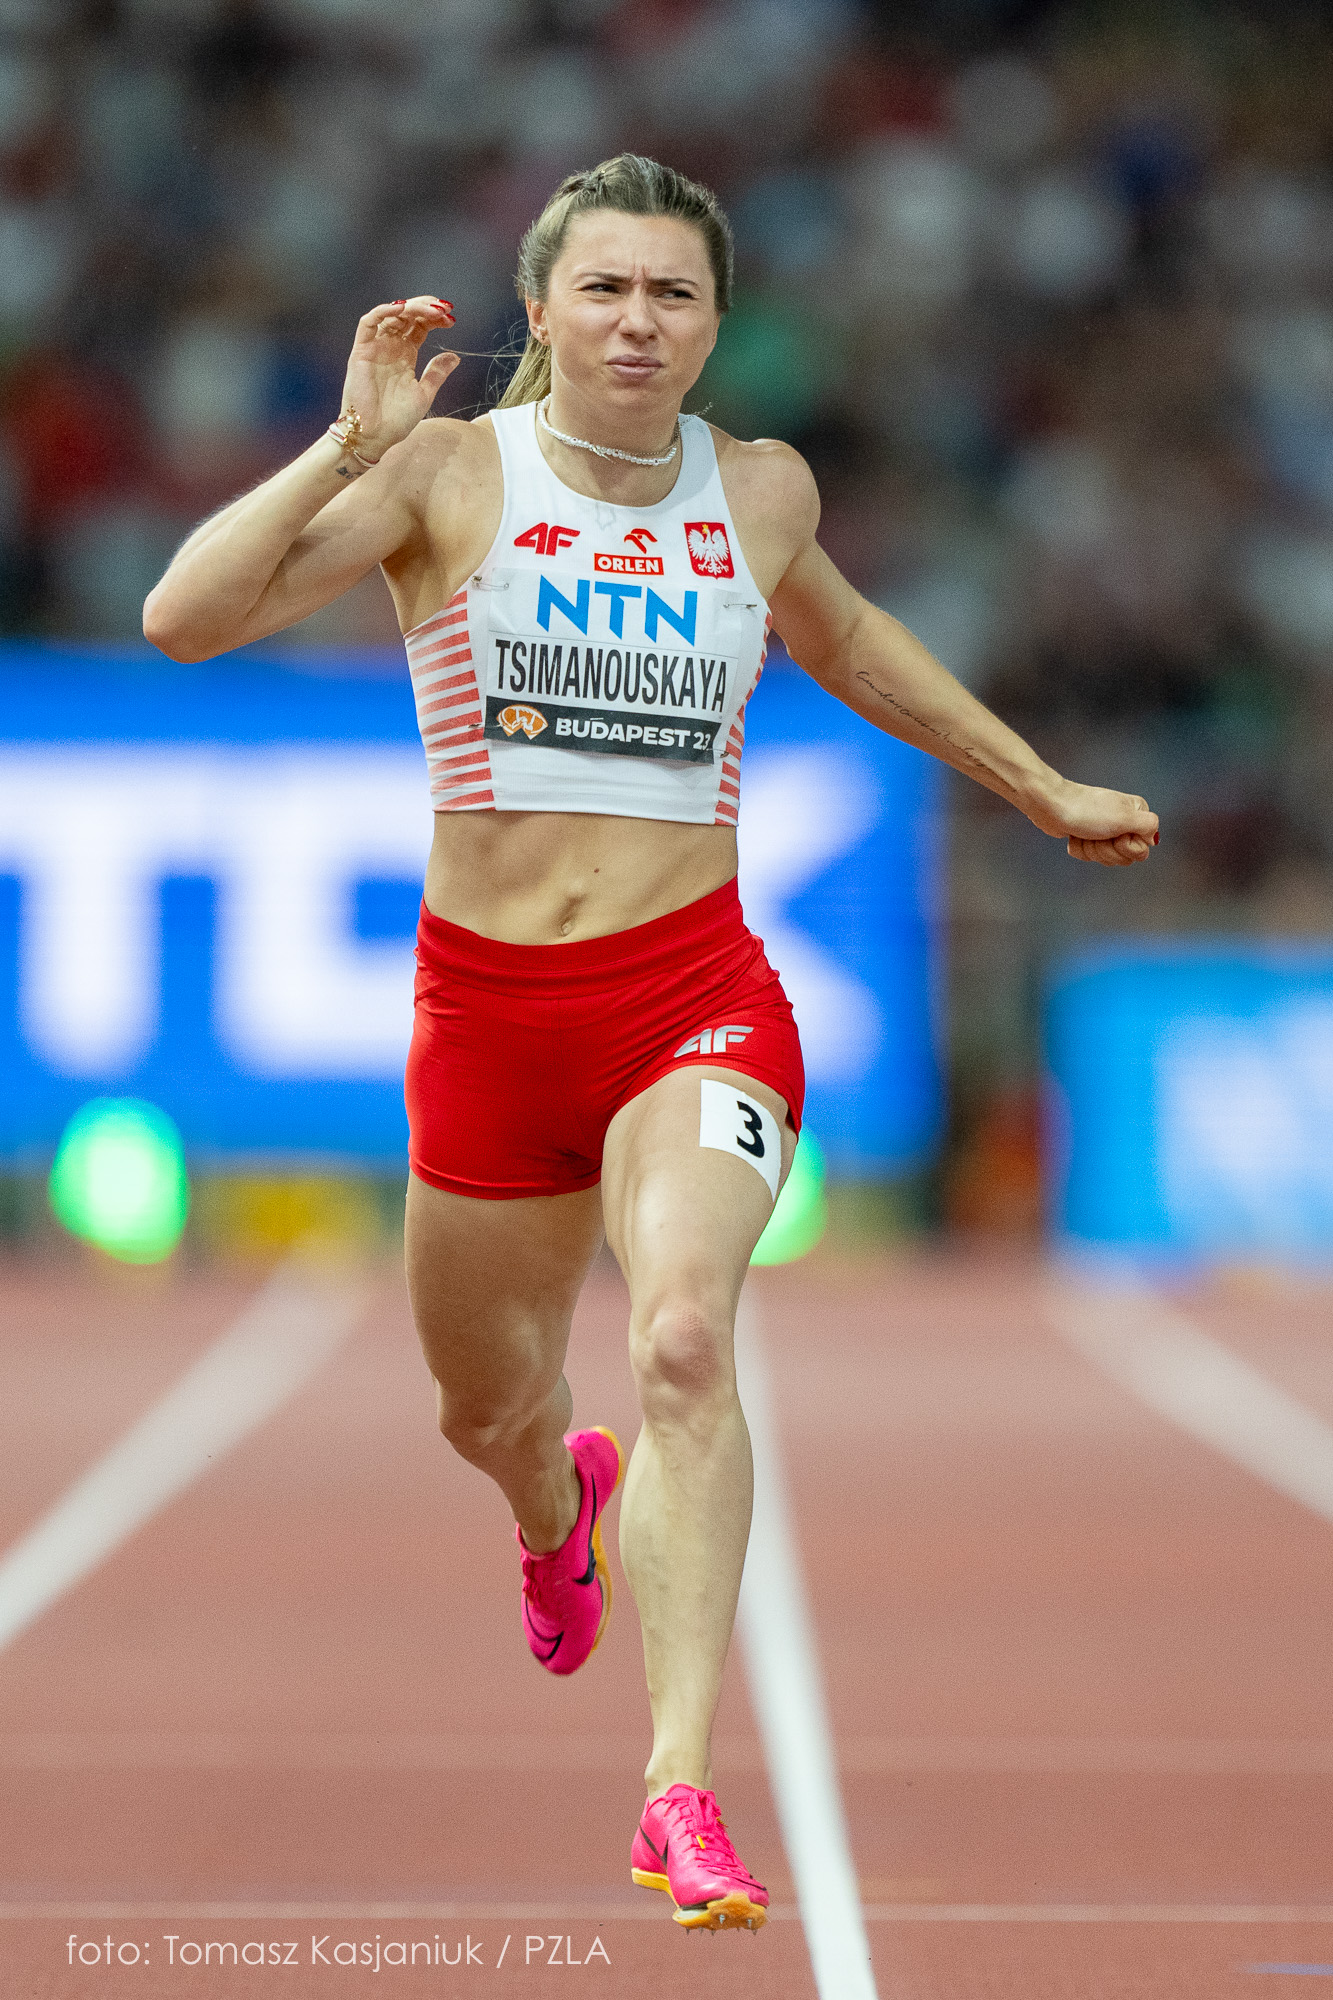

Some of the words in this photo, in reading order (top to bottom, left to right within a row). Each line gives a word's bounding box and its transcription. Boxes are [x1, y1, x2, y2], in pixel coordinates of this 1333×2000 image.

[513, 521, 581, 557] 4F
[597, 556, 660, 574] ORLEN
[536, 574, 698, 647] NTN
[495, 638, 728, 713] TSIMANOUSKAYA
[555, 716, 691, 748] BUDAPEST
[673, 1024, 754, 1058] 4F
[736, 1100, 765, 1158] 3
